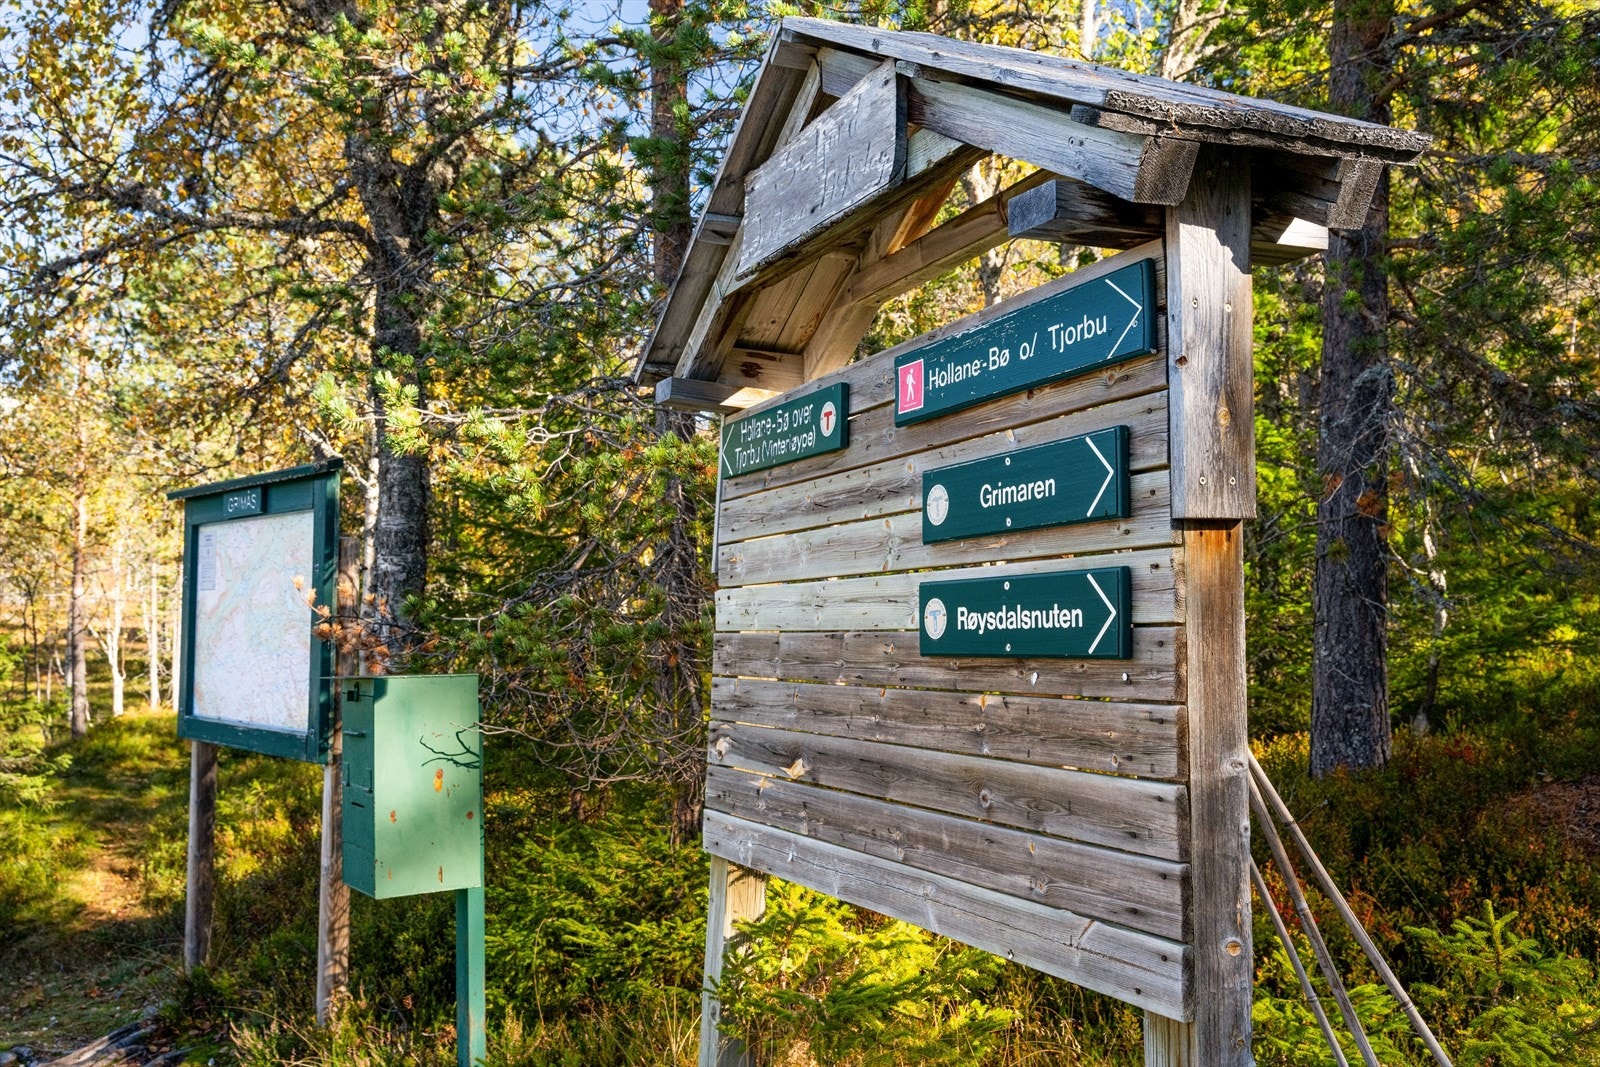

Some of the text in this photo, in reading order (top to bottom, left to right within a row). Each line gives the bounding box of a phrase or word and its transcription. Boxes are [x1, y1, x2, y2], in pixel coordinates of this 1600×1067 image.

[929, 314, 1107, 391] Hollane-Bø o/ Tjorbu
[740, 404, 813, 443] Hollane-Bø over
[735, 444, 759, 473] Tjorbu
[228, 490, 256, 512] GRIMÅS
[979, 478, 1056, 508] Grimaren
[957, 603, 1083, 635] Røysdalsnuten
